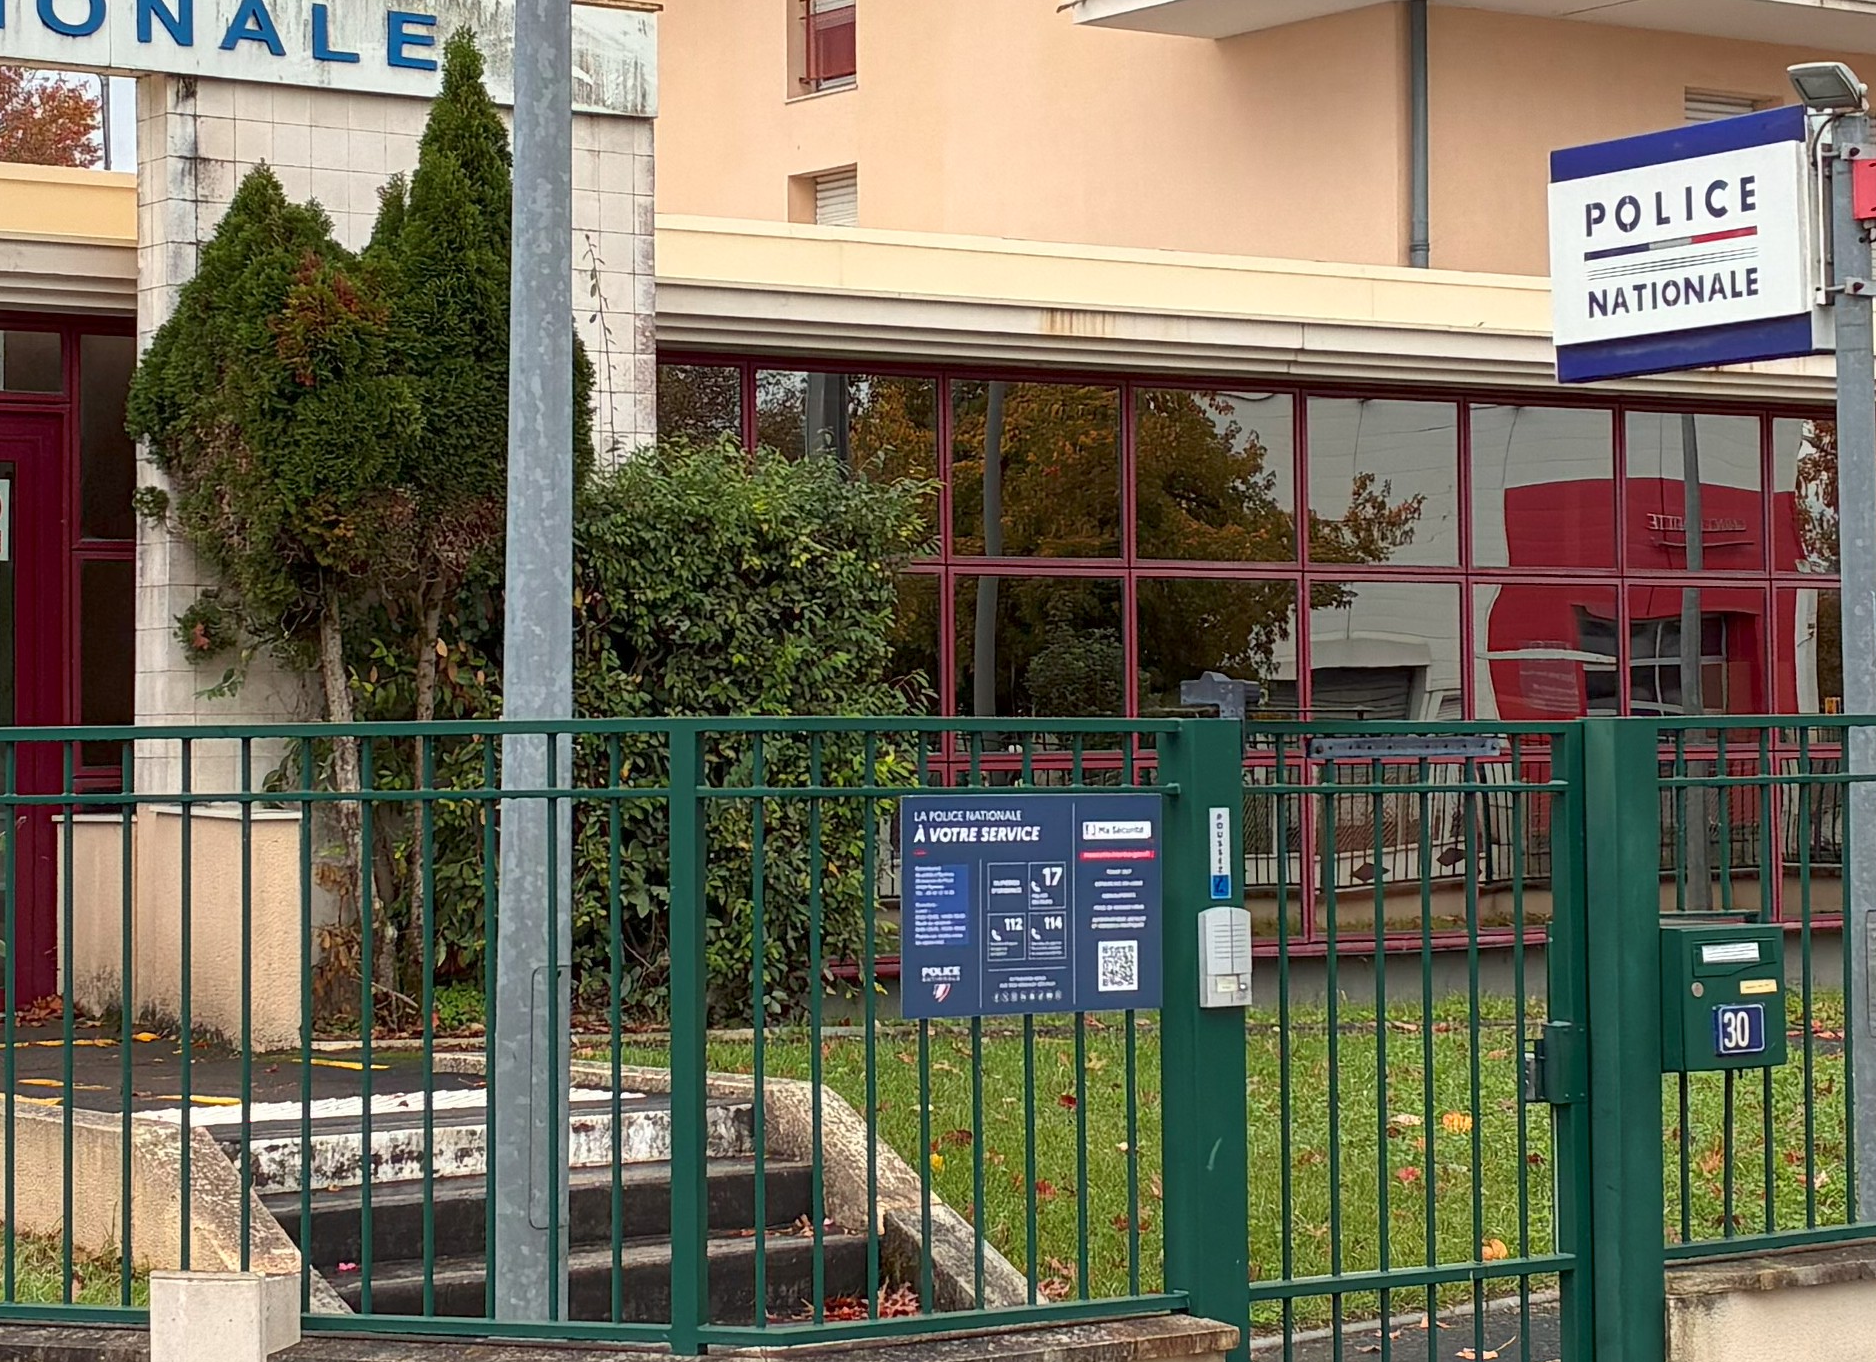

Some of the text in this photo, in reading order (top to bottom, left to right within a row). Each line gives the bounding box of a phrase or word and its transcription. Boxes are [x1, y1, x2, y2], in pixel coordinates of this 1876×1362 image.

[1584, 175, 1757, 238] POLICE
[1587, 267, 1759, 319] NATIONALE
[913, 810, 1022, 822] LA POLICE NATIONALE
[913, 824, 1041, 843] À VOTRE SERVICE
[1042, 866, 1063, 887] 17
[1004, 917, 1023, 931] 112
[921, 966, 961, 977] POLICE
[1723, 1010, 1749, 1049] 30
